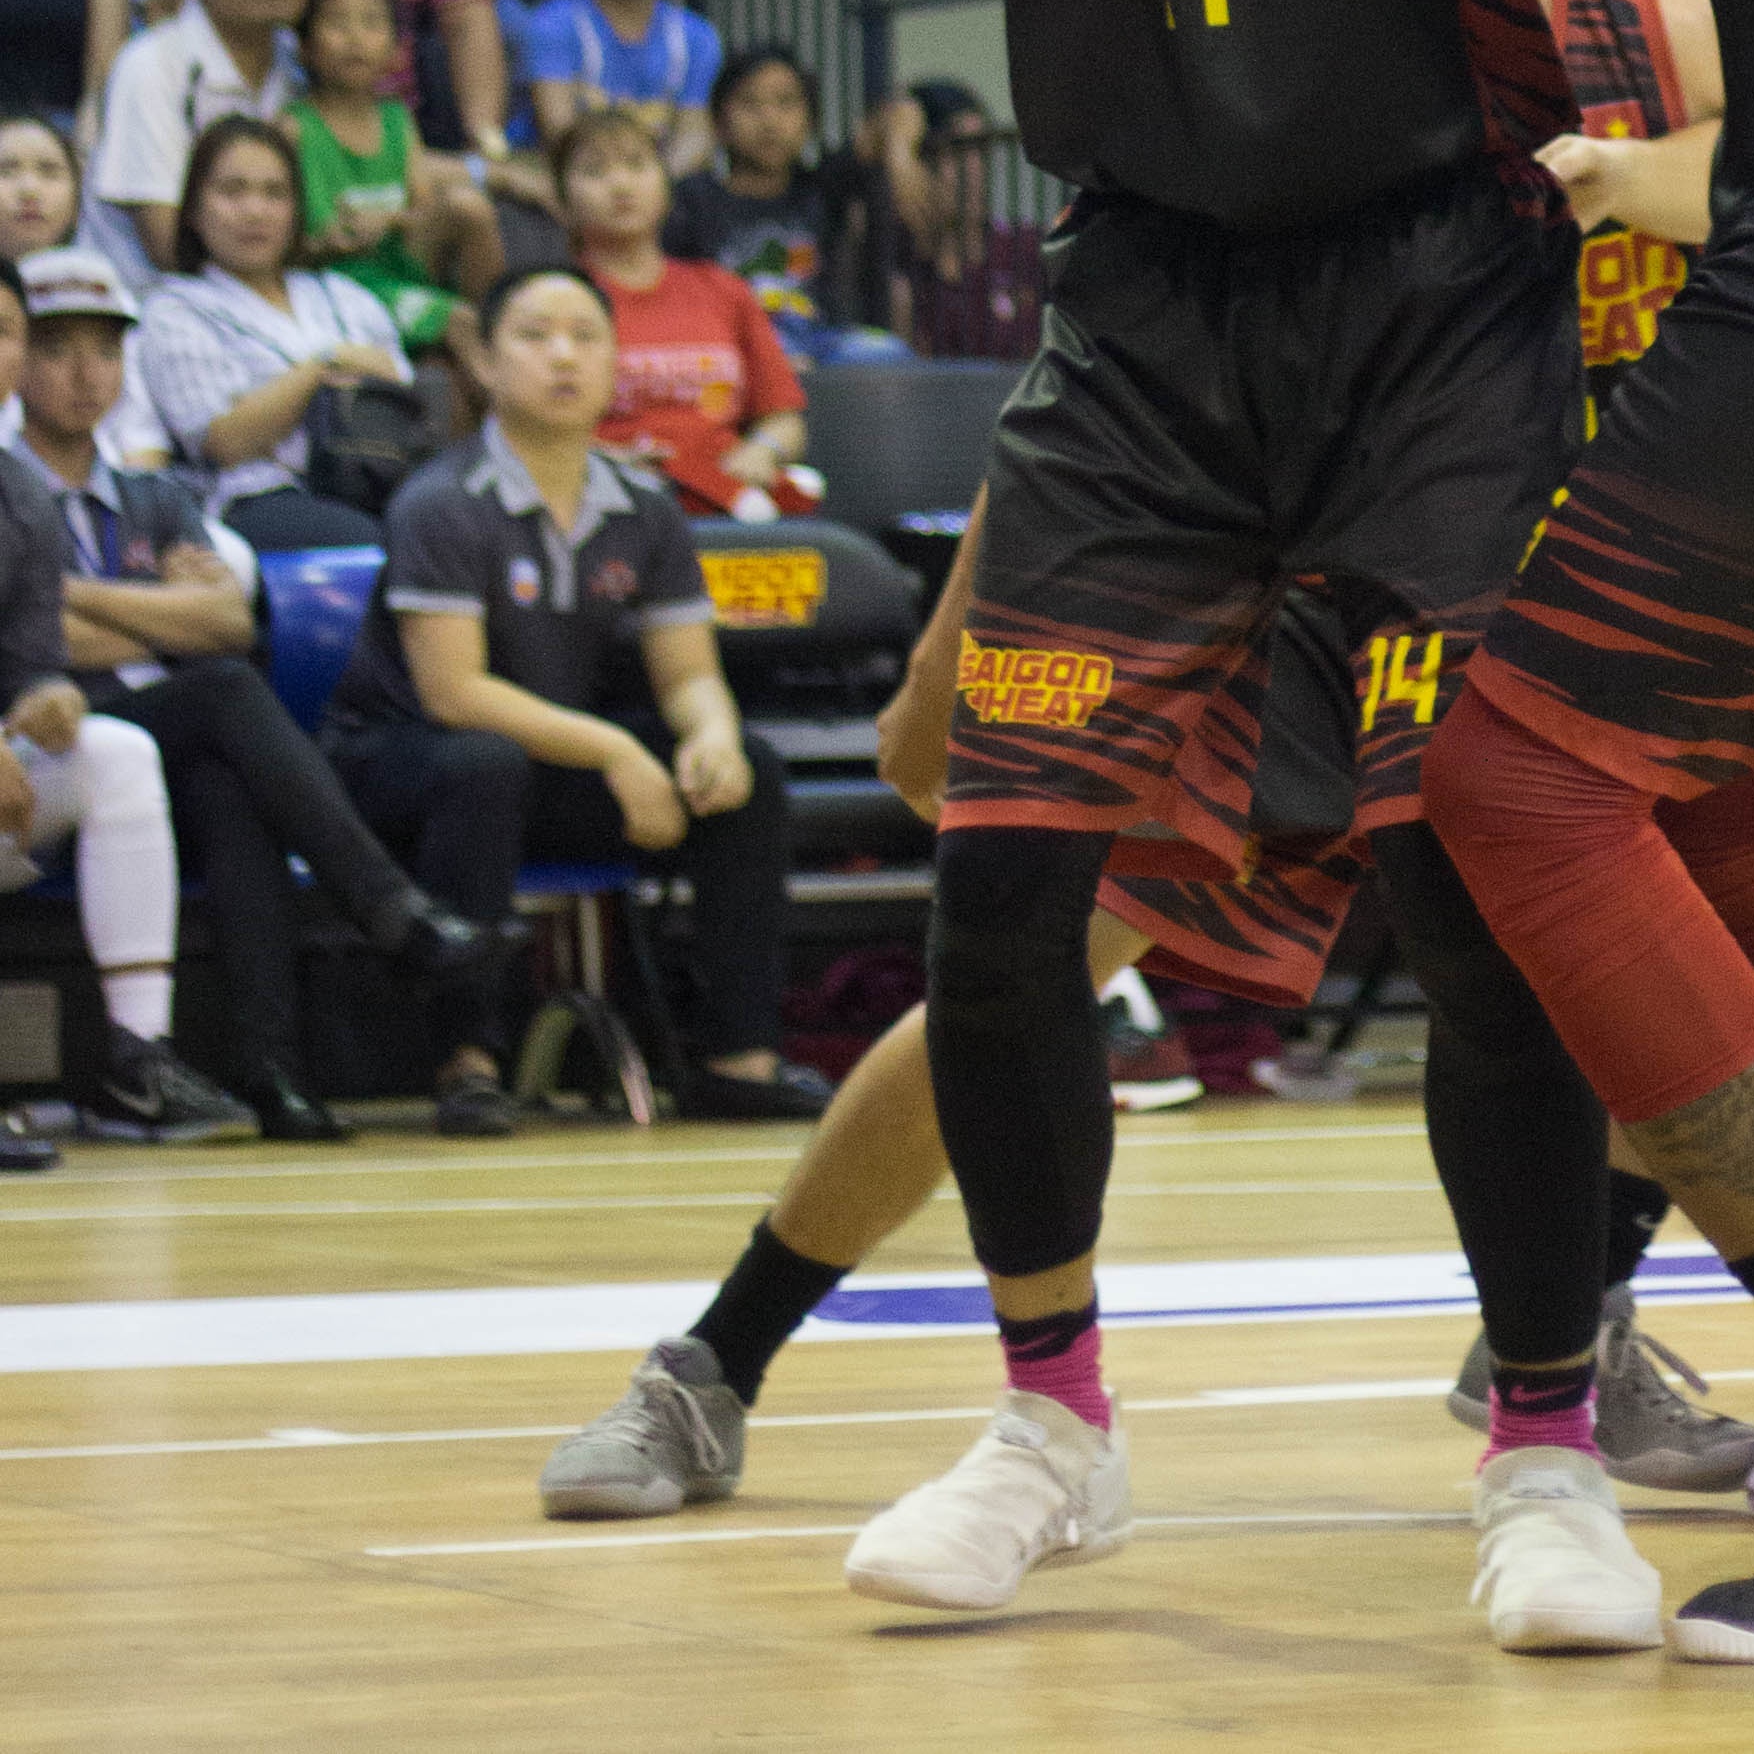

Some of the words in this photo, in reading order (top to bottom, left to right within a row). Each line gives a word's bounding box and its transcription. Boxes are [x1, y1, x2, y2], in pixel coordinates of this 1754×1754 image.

[960, 649, 1111, 692] SAIGON
[1361, 631, 1444, 732] 14
[983, 686, 1104, 726] HEAT
